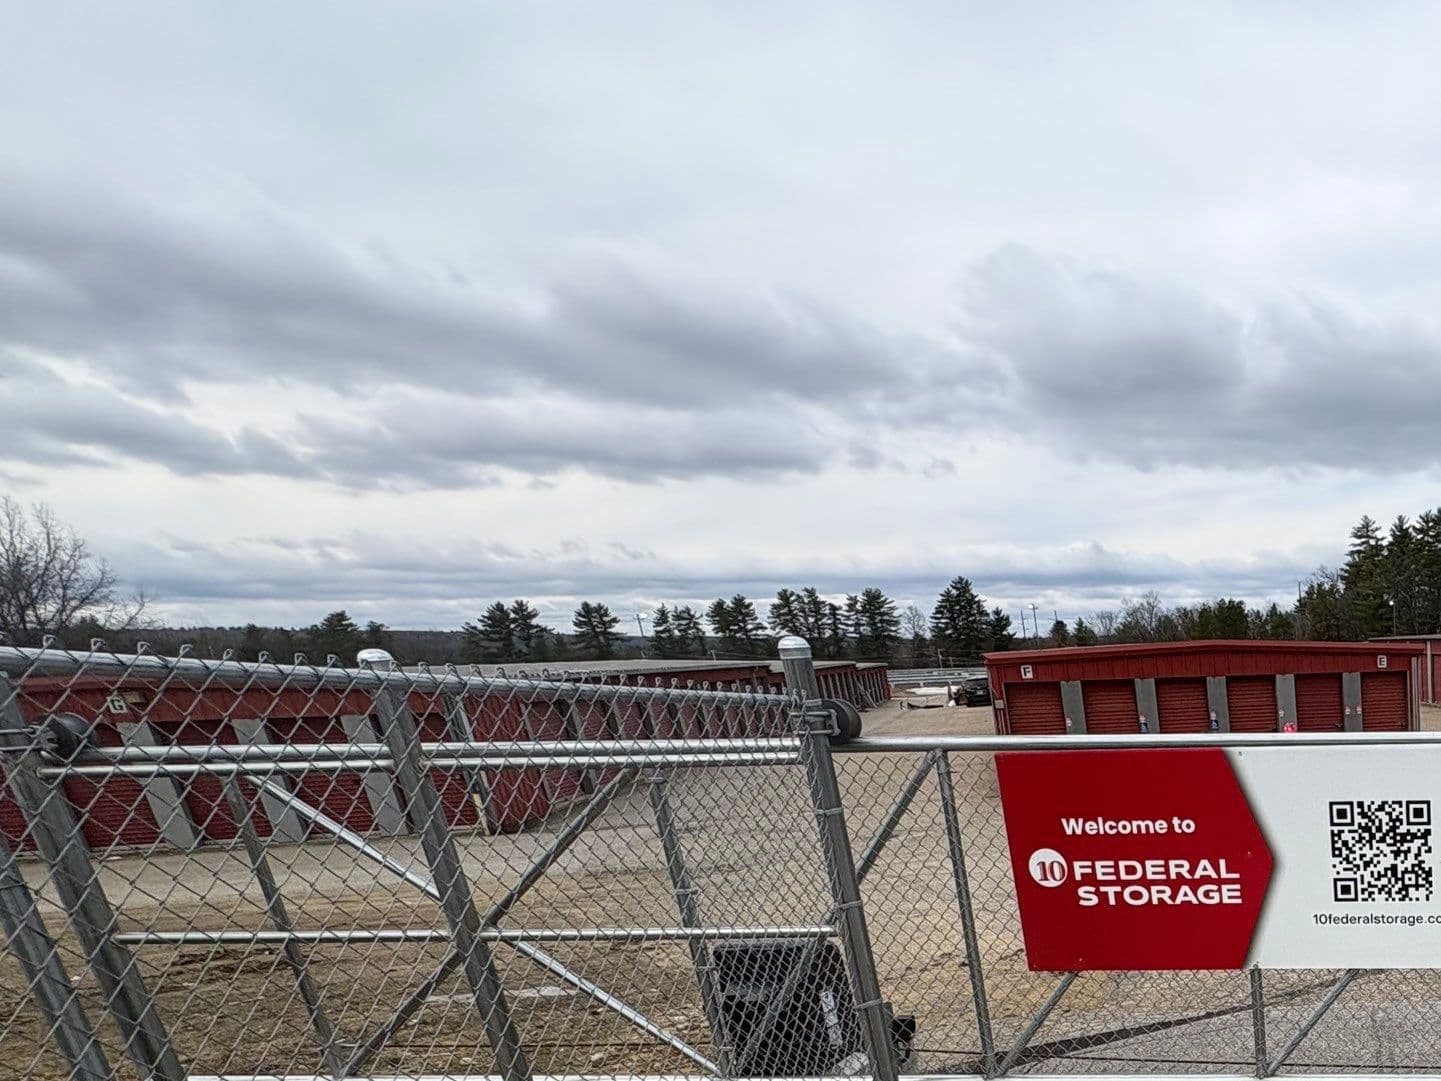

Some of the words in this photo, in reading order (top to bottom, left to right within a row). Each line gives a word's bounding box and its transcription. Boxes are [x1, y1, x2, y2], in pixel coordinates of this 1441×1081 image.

[1022, 666, 1031, 677] F
[110, 699, 124, 711] G
[1061, 817, 1168, 836] Welcome
[1171, 816, 1196, 834] to
[1035, 858, 1065, 882] 10
[1073, 858, 1240, 881] FEDERAL
[1077, 884, 1243, 906] STORAGE
